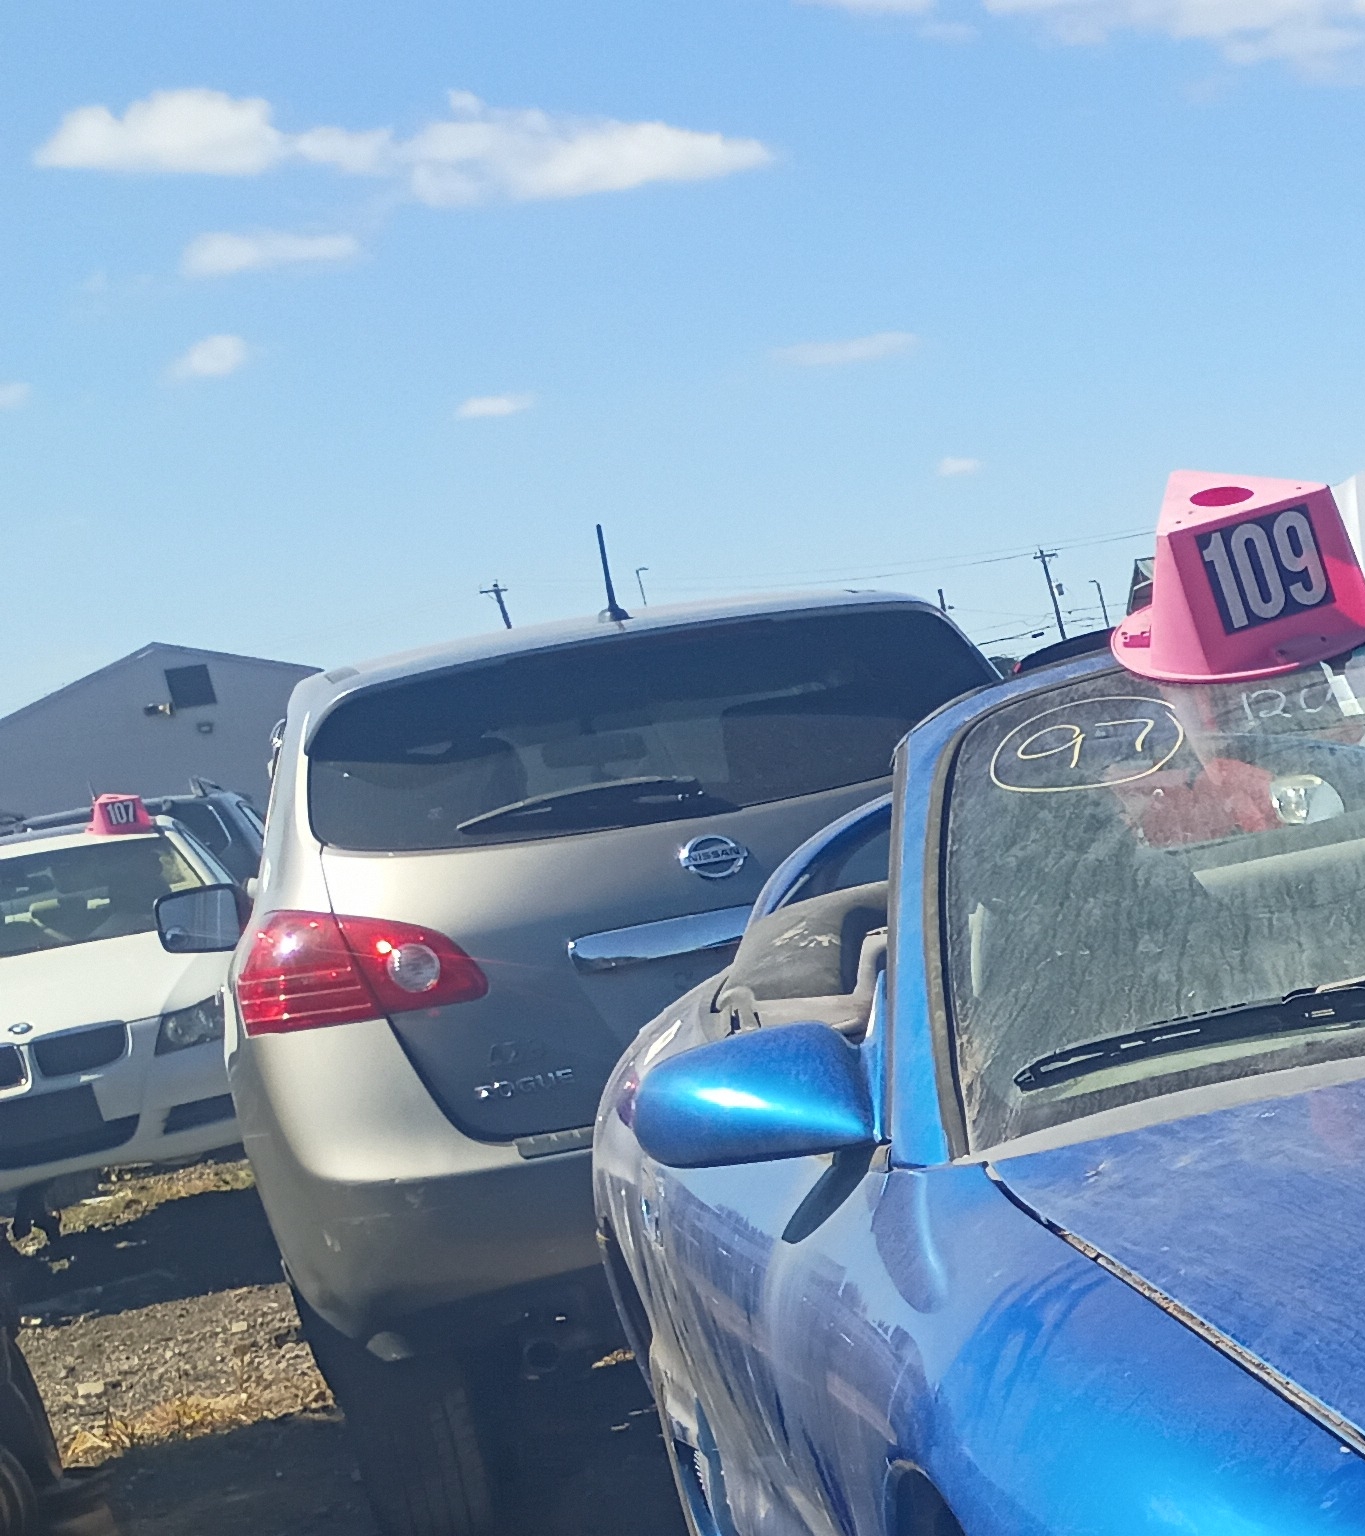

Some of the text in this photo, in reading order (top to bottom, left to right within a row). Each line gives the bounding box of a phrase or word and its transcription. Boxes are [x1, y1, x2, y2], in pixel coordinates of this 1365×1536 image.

[1202, 510, 1327, 629] 109
[1016, 717, 1155, 769] 97
[106, 800, 134, 825] 107
[687, 846, 741, 863] NISSAN
